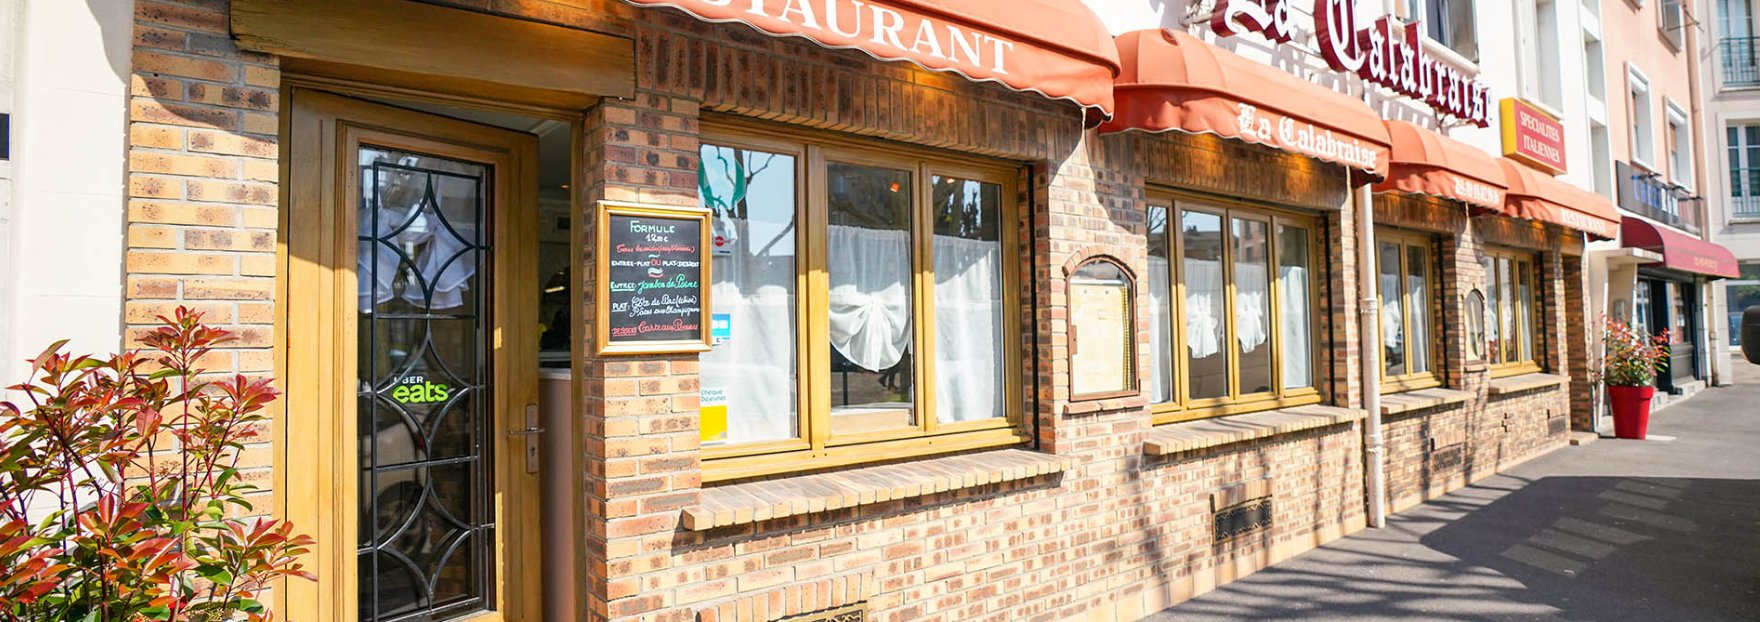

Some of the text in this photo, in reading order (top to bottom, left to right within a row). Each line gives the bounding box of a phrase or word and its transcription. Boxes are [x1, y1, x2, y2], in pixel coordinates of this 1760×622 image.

[702, 0, 1013, 75] AURANT
[1237, 102, 1377, 169] La Calabraise
[1520, 111, 1560, 144] SPECIALITES
[1523, 134, 1560, 163] ITALIENNES
[393, 381, 449, 404] eats
